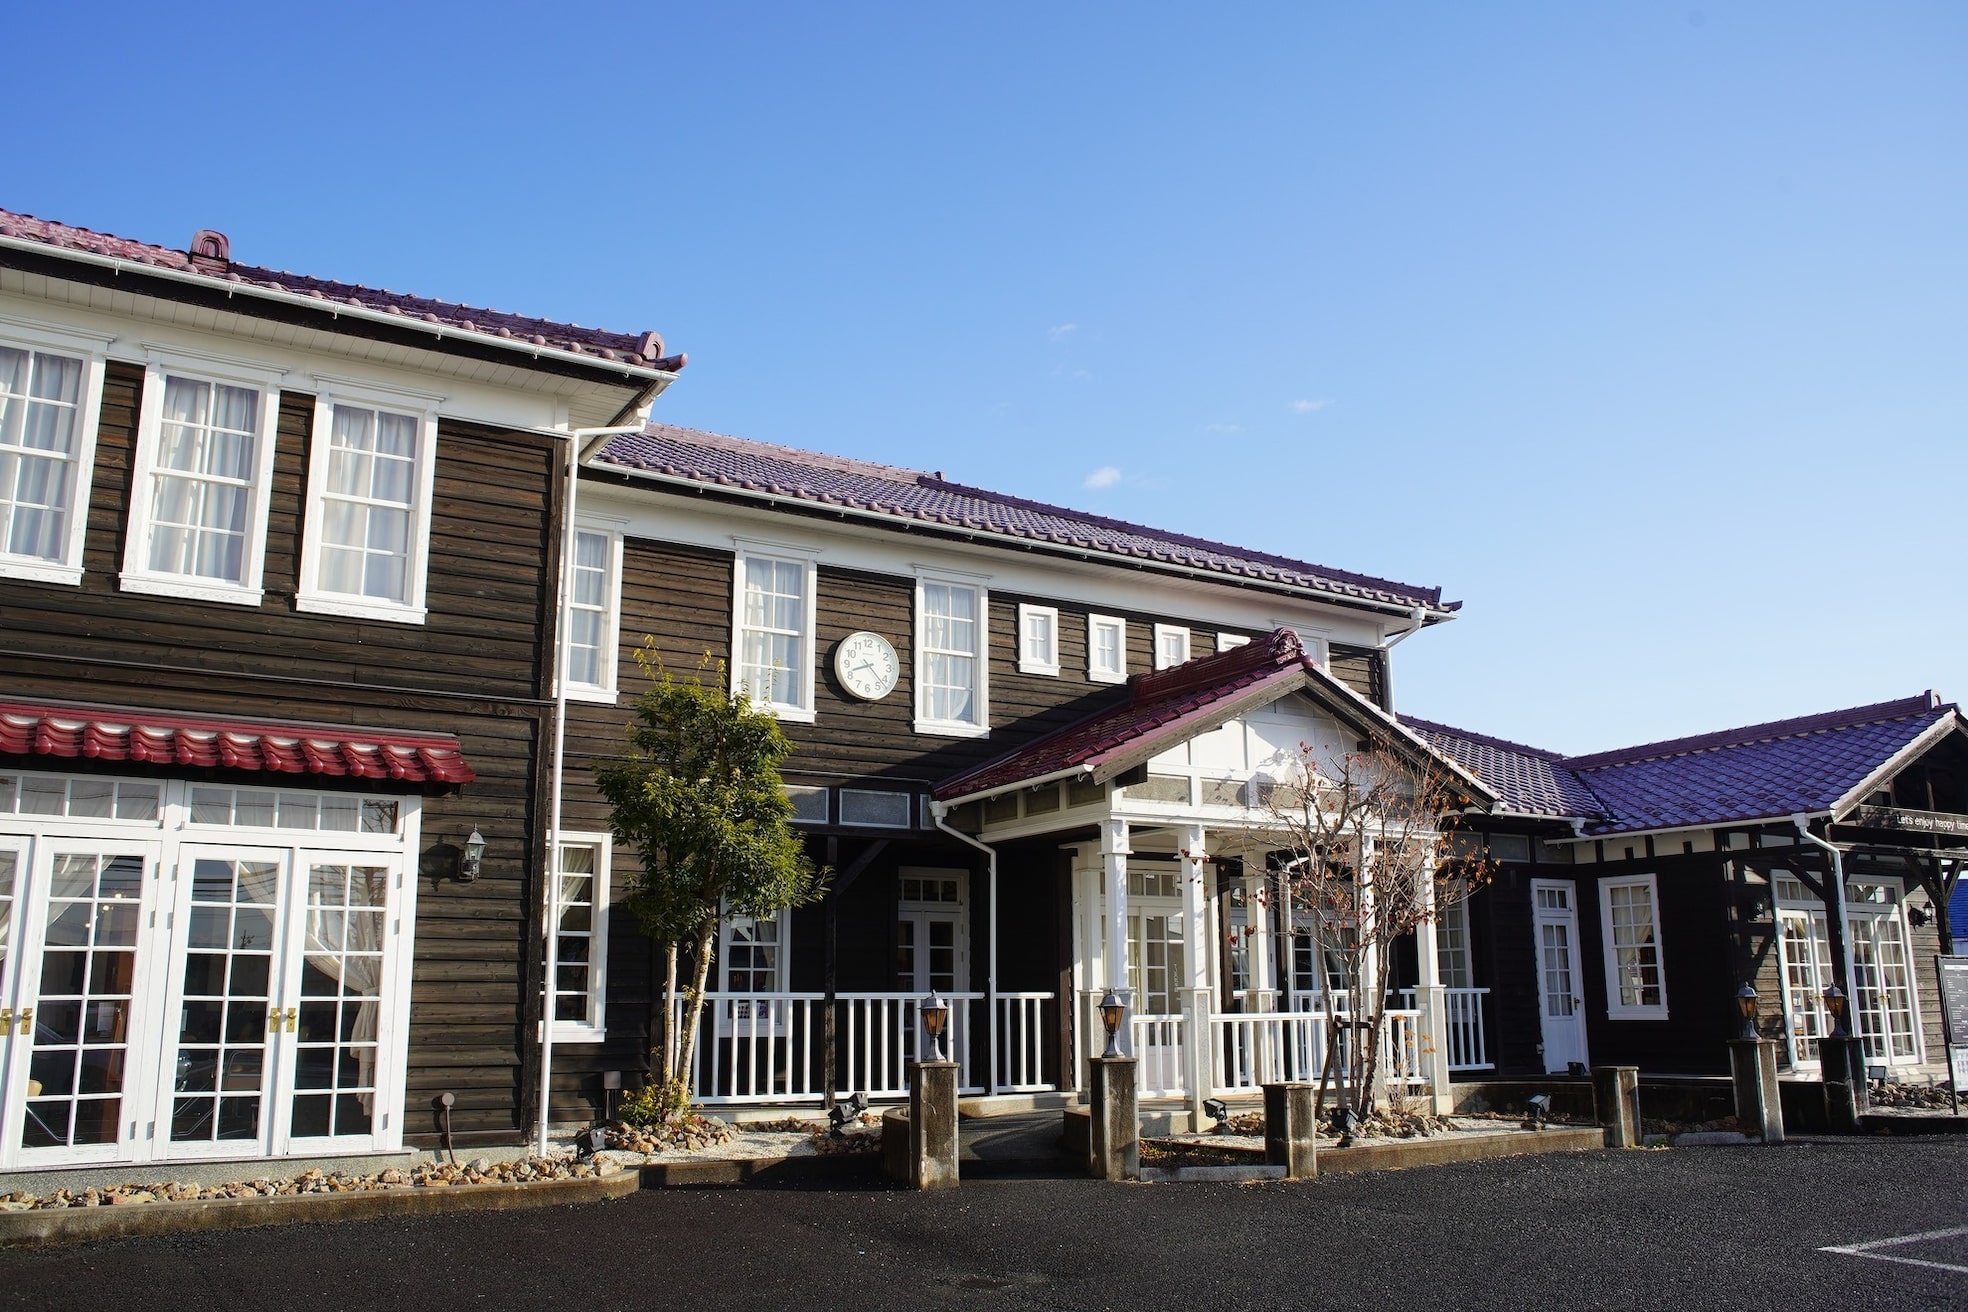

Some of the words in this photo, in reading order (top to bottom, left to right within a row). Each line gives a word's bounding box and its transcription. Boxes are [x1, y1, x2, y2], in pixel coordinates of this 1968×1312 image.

[853, 641, 862, 650] 11
[863, 638, 873, 648] 12
[846, 649, 856, 659] 10
[882, 652, 889, 661] 2
[843, 659, 850, 668] 9
[885, 664, 892, 673] 3
[847, 670, 854, 680] 8
[882, 674, 888, 683] 4
[855, 679, 862, 689] 7
[864, 683, 871, 693] 6
[874, 681, 881, 691] 5
[1915, 817, 1934, 830] enjoy
[1935, 817, 1955, 831] happy
